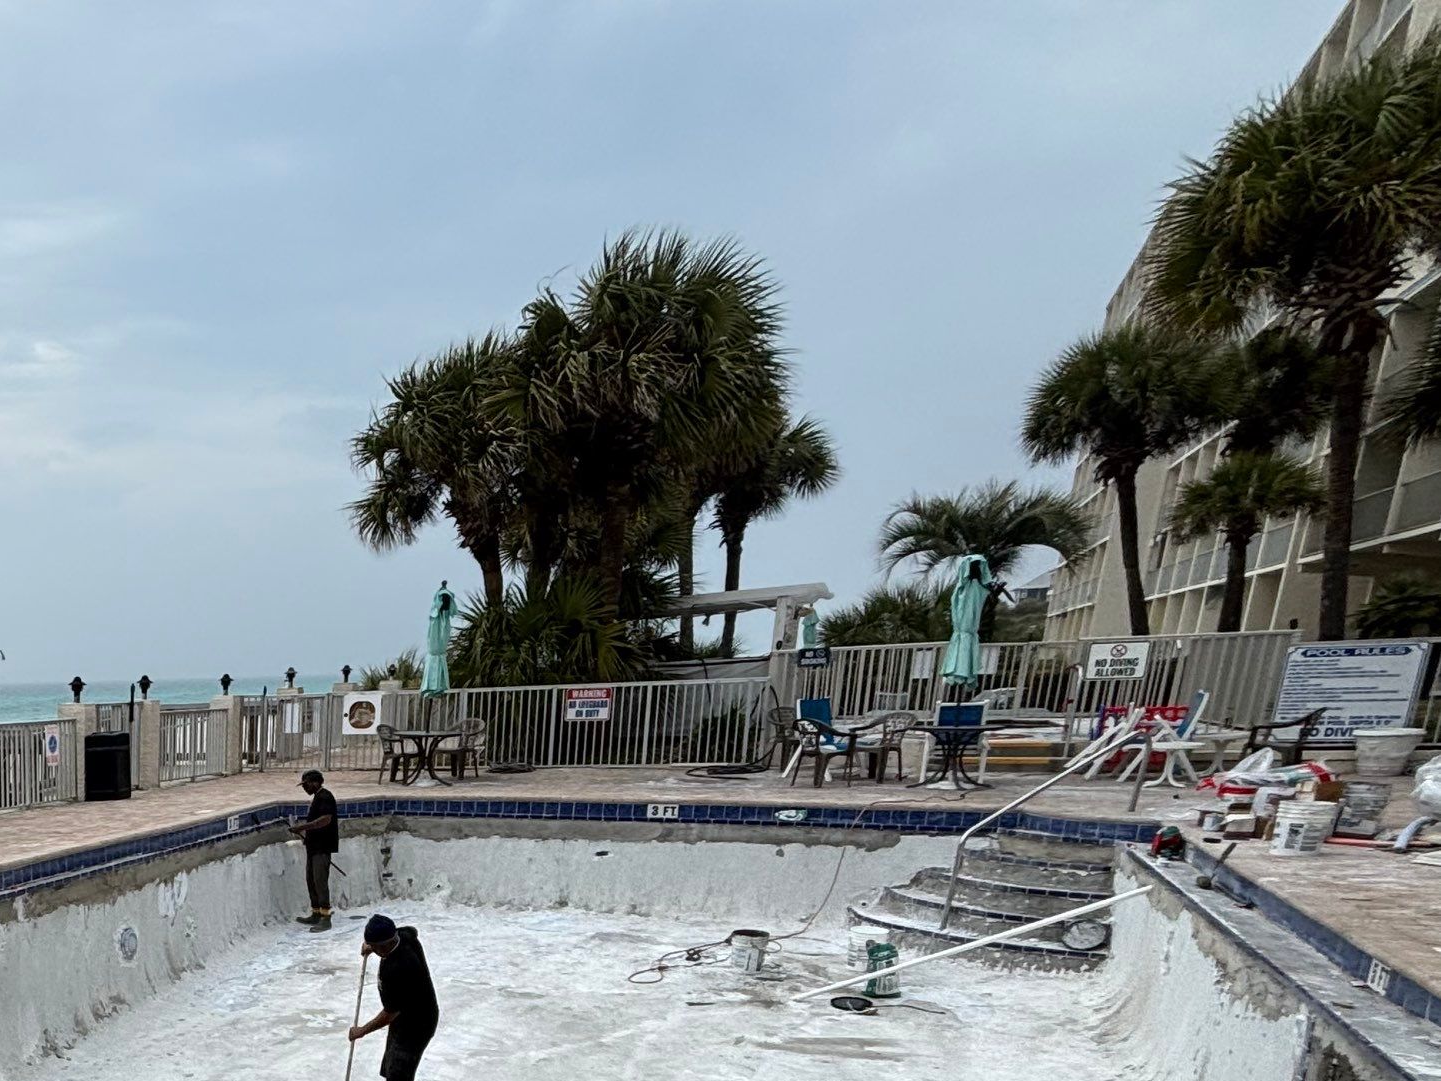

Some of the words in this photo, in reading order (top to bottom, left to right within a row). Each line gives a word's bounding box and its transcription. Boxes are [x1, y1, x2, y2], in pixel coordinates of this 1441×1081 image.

[1306, 649, 1351, 657] POOL
[1354, 647, 1406, 656] RULES
[1094, 659, 1108, 668] NO
[1109, 657, 1139, 668] DIVING
[1094, 668, 1136, 677] ALLOWED
[572, 689, 607, 698] WARNING
[651, 805, 660, 817] 3
